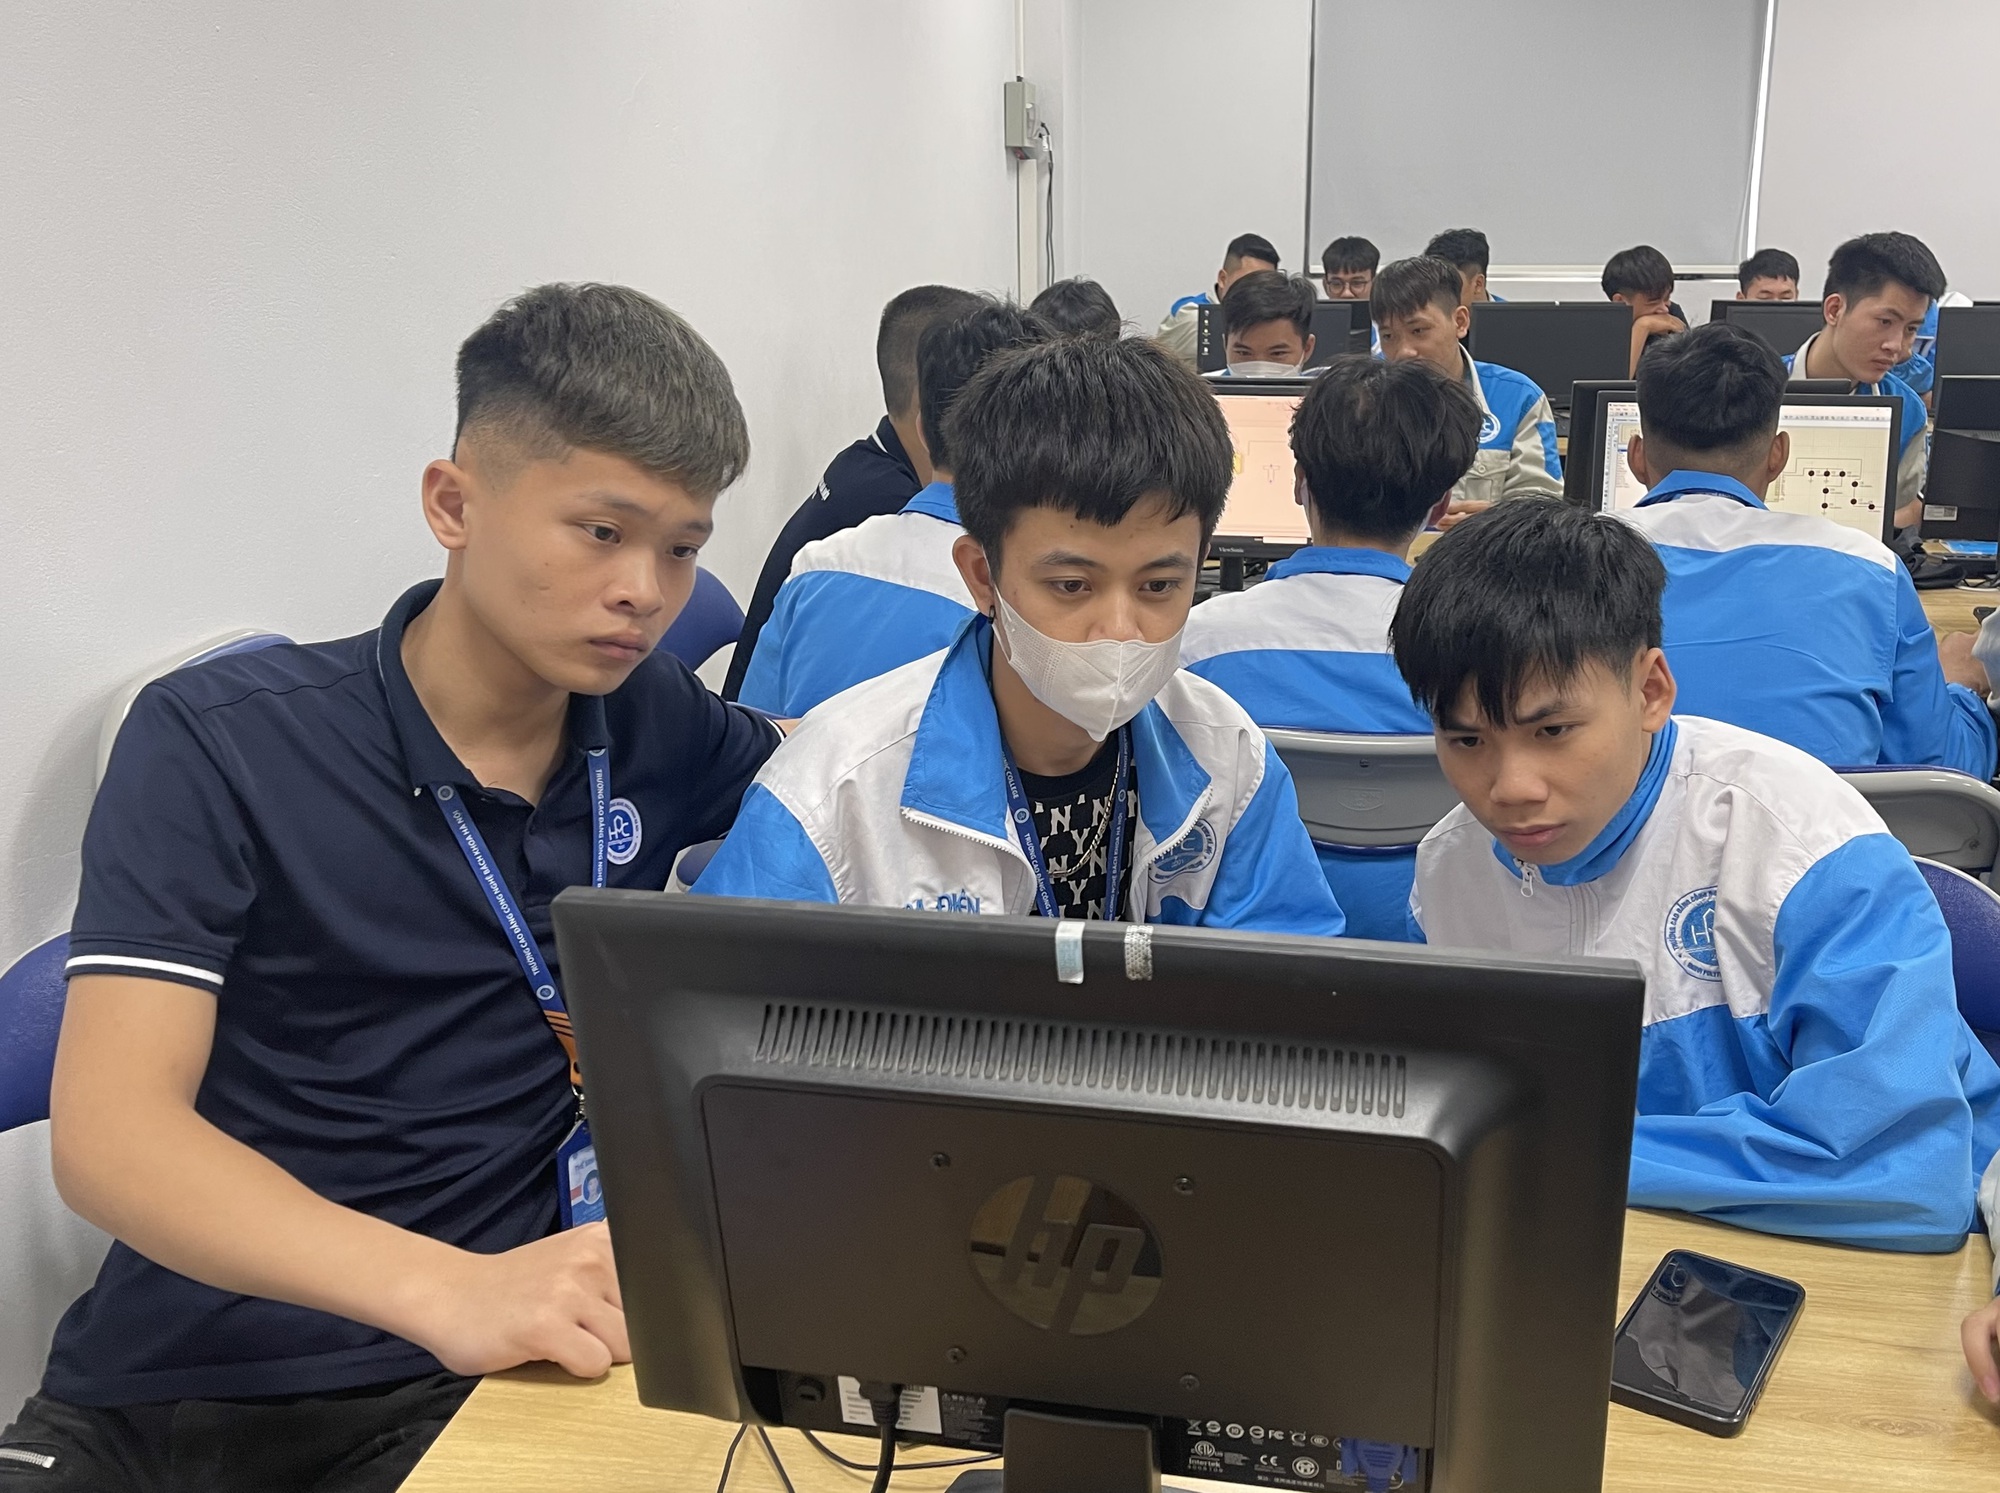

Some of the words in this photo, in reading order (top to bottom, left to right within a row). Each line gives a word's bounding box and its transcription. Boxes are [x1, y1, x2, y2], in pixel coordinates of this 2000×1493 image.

[1005, 770, 1019, 799] COLLEGE
[450, 808, 465, 824] NỘI
[457, 822, 470, 836] HÀ
[464, 834, 481, 856] KHOA
[474, 854, 491, 876] BÁCH
[1031, 859, 1040, 873] CAO
[1040, 890, 1051, 909] CÔNG
[494, 892, 511, 914] CÔNG
[514, 932, 528, 948] CAO
[521, 946, 539, 975] TRƯỜNG
